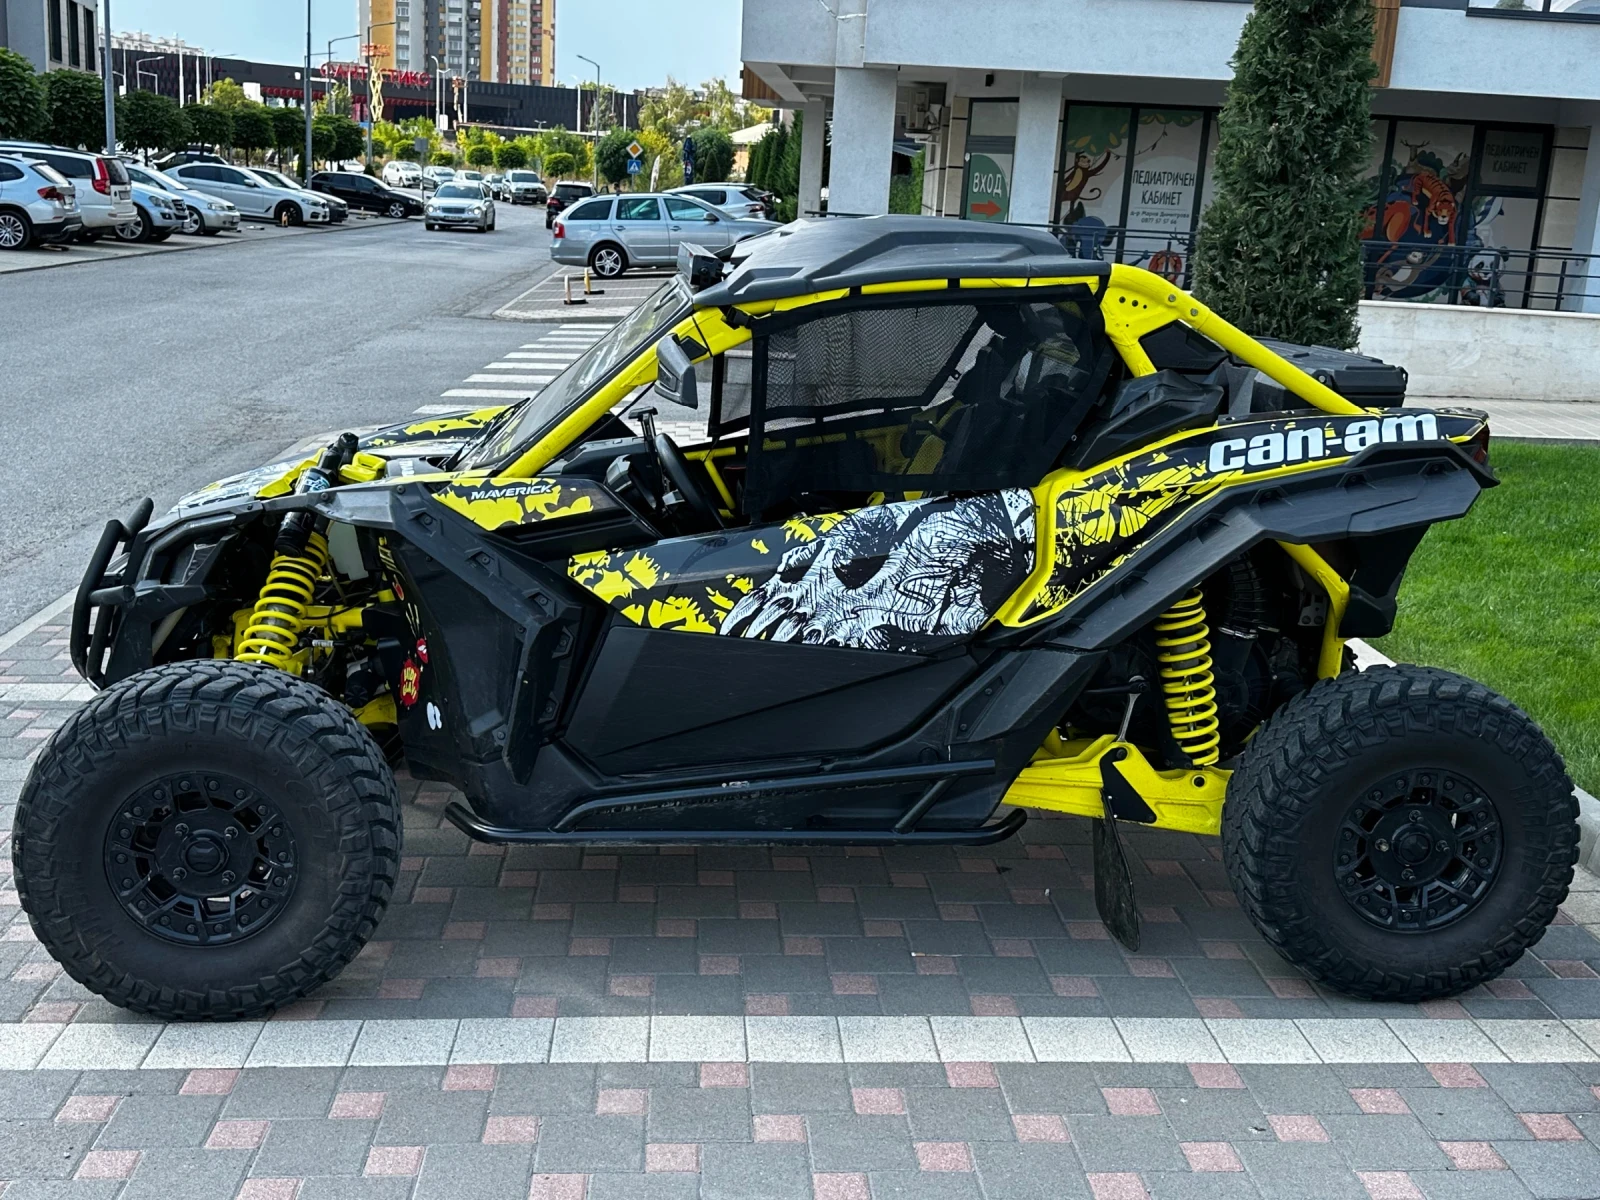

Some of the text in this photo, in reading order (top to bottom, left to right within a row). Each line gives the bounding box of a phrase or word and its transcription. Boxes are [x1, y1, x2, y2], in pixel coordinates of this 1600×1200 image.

[1485, 144, 1540, 158] ПЕДИАТРИЧЕН
[1492, 160, 1528, 174] КАБИНЕТ
[972, 172, 1002, 198] ВХОД
[1132, 170, 1195, 187] ПЕДИАТРИЧЕН
[1141, 190, 1182, 206] КАБИНЕТ
[1209, 413, 1438, 473] can-am
[470, 484, 554, 500] MAVERICK
